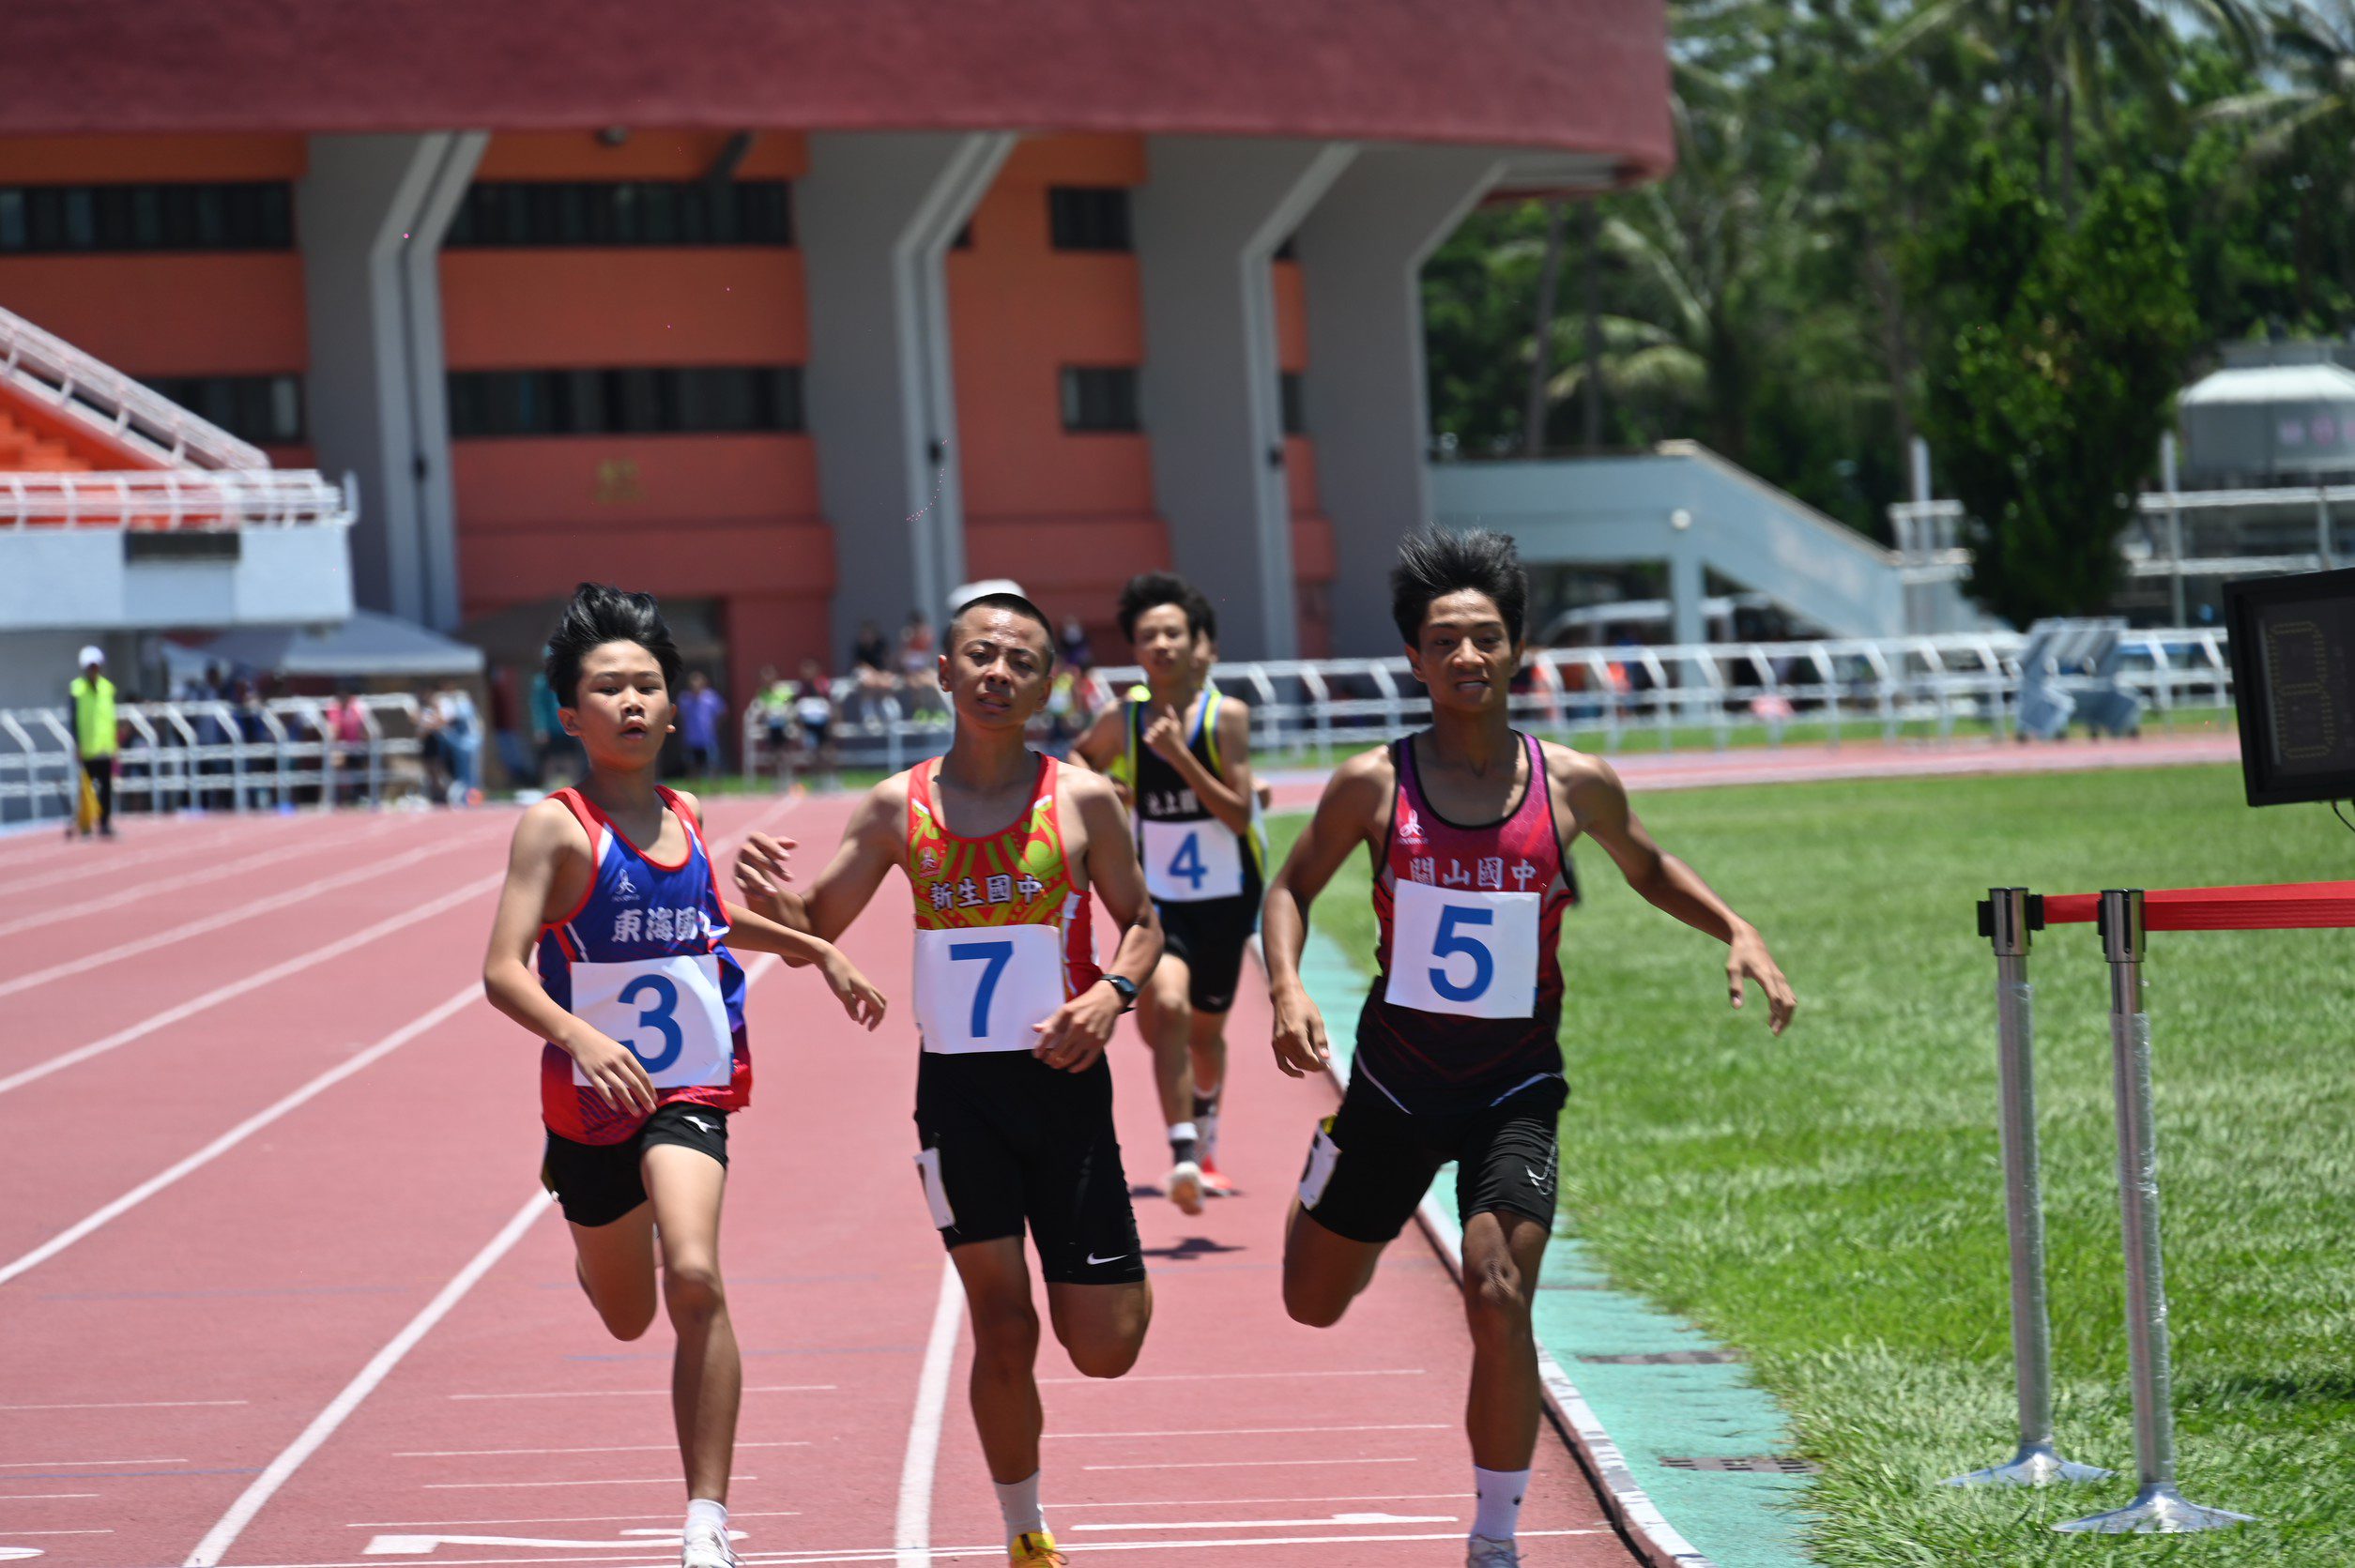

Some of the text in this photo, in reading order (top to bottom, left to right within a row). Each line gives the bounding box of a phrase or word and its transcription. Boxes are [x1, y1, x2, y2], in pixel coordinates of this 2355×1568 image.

[930, 874, 1044, 912] 新生國中
[1168, 830, 1207, 890] 4
[949, 940, 1015, 1038] 7
[1428, 904, 1494, 1003] 5
[617, 974, 684, 1073] 3
